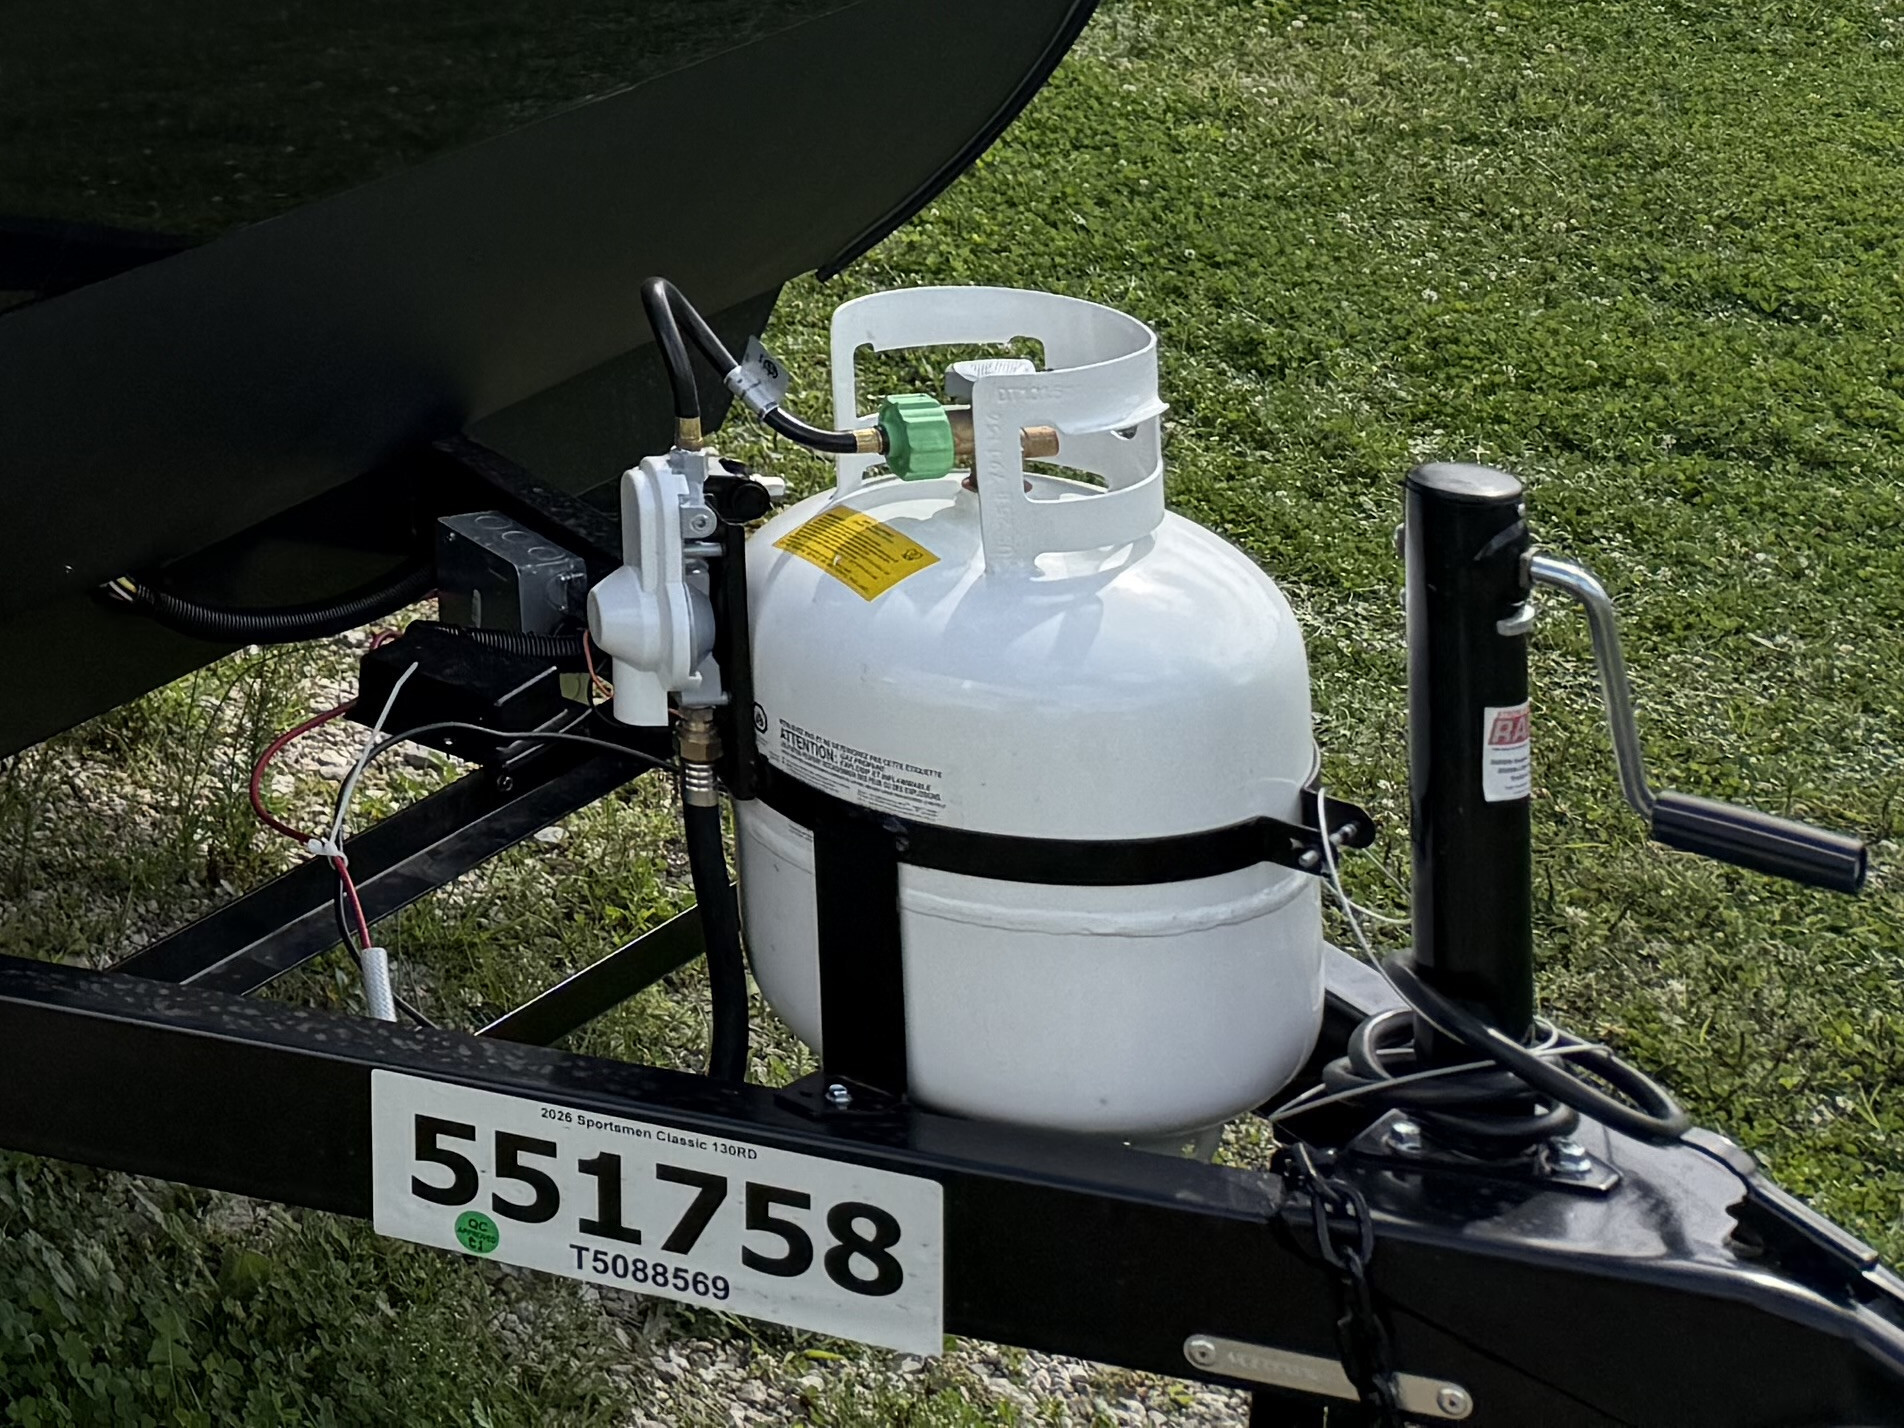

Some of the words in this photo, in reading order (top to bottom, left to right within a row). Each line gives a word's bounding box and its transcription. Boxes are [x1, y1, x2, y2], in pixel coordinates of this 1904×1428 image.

[541, 1107, 572, 1123] 2026
[577, 1115, 652, 1140] Sportsmen
[656, 1130, 708, 1151] Classic
[713, 1142, 758, 1160] 130RD
[411, 1114, 904, 1297] 551758
[468, 1218, 488, 1232] QC
[570, 1244, 731, 1301] T5088569
